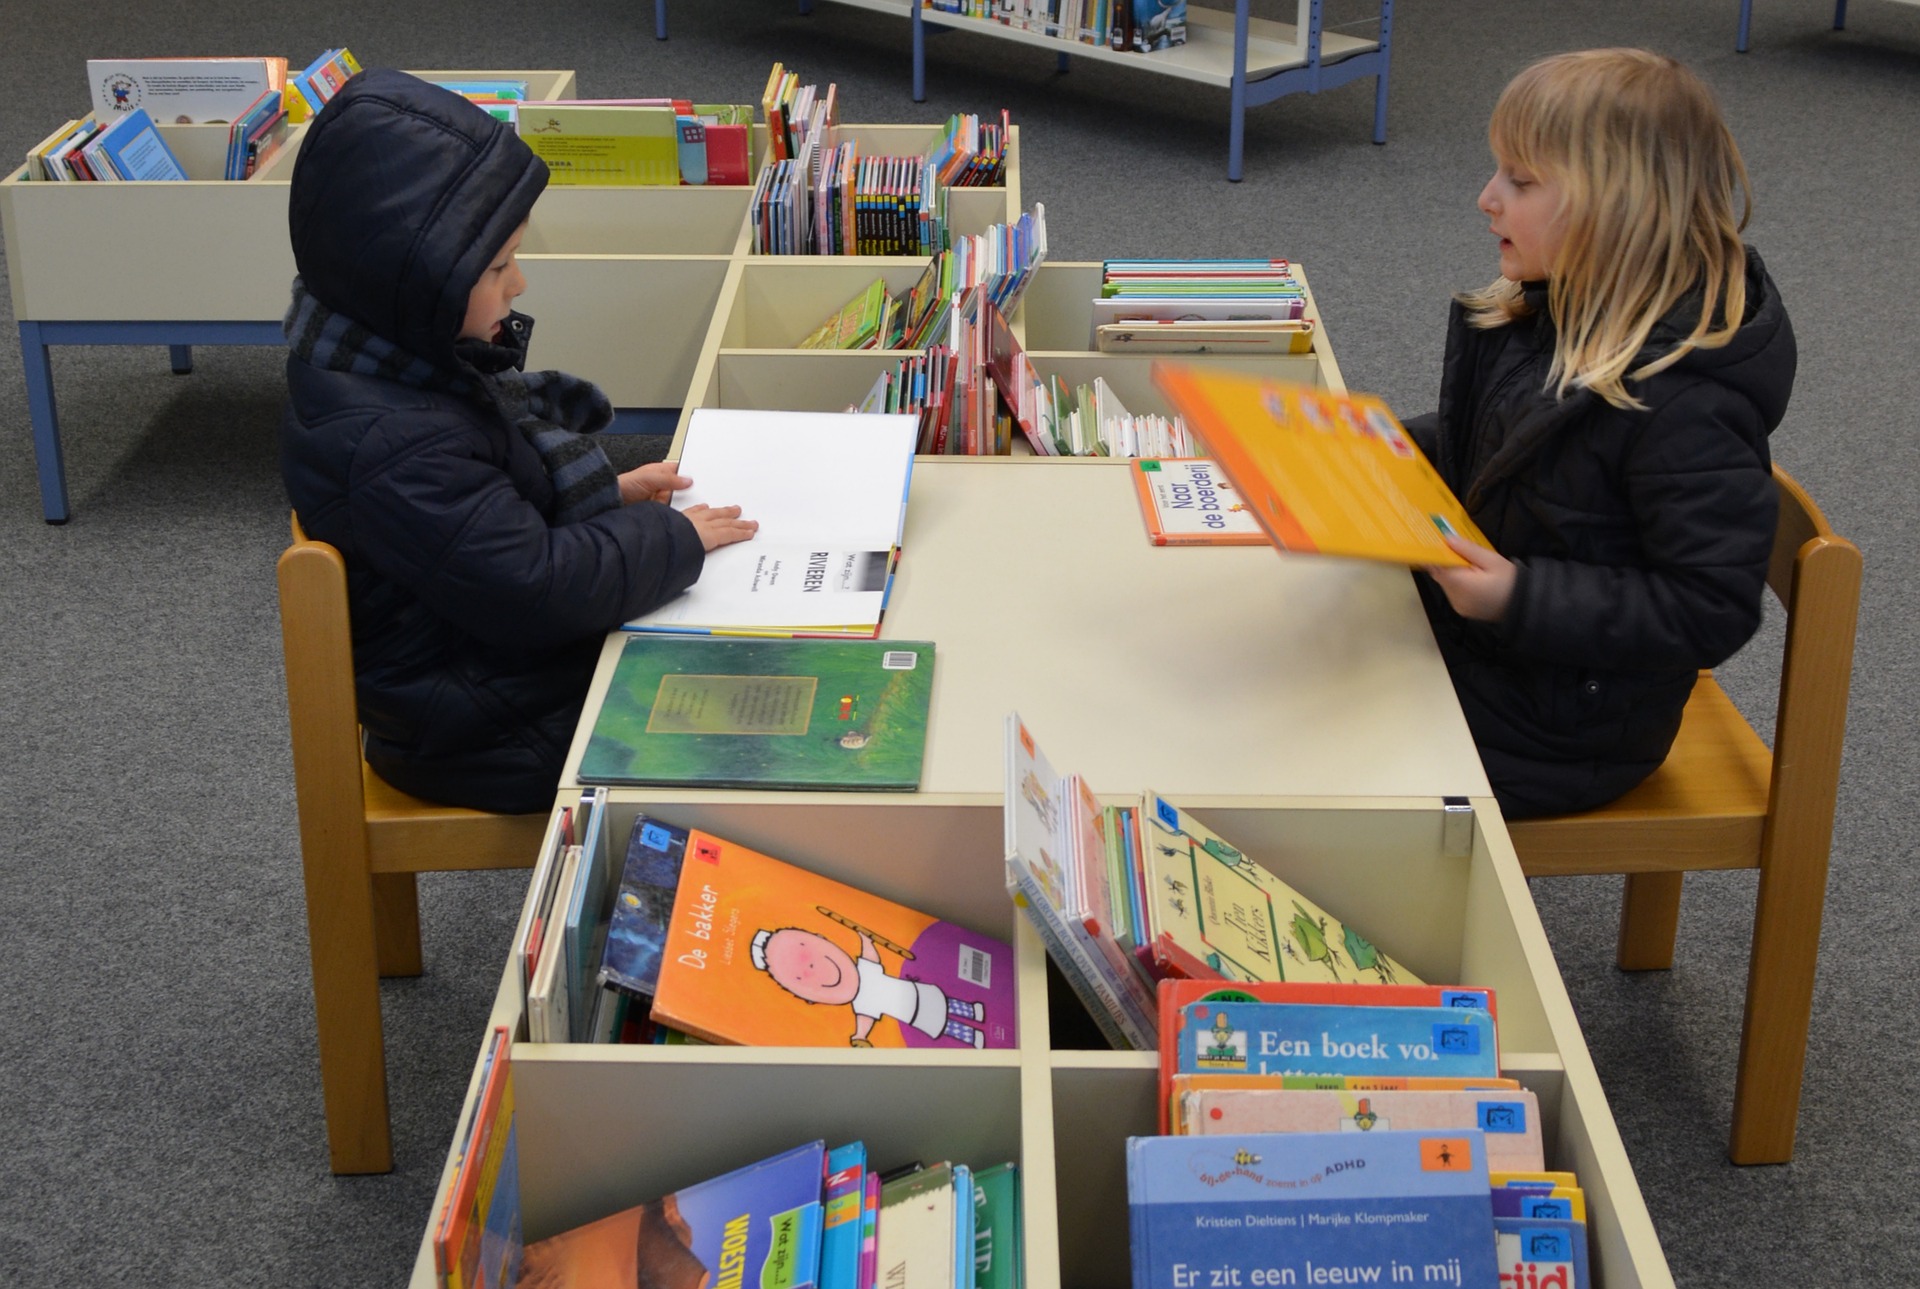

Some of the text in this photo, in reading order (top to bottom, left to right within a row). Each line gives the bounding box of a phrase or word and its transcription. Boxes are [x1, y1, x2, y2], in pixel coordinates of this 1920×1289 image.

[1171, 483, 1195, 509] Naar
[1184, 463, 1226, 529] de boerderij
[802, 552, 829, 593] RIVIEREN
[677, 884, 719, 970] De bakker
[1222, 902, 1248, 934] Tien
[1245, 905, 1271, 963] Kikkers
[1022, 876, 1038, 898] HET
[1036, 896, 1062, 932] GROTE
[1058, 927, 1078, 956] BOEK
[1075, 953, 1099, 983] OVER
[1094, 982, 1128, 1026] FAMILIES
[1258, 1031, 1311, 1057] Een
[1321, 1032, 1389, 1060] boek
[1325, 1158, 1367, 1176] ADHD
[778, 1217, 793, 1247] Wat
[1195, 1215, 1242, 1228] Kristien
[1245, 1214, 1297, 1228] Dieltiens
[1308, 1212, 1352, 1228] Marijke
[1355, 1211, 1430, 1226] Klompmaker
[1172, 1258, 1462, 1288] Er zit een leeuw in mij
